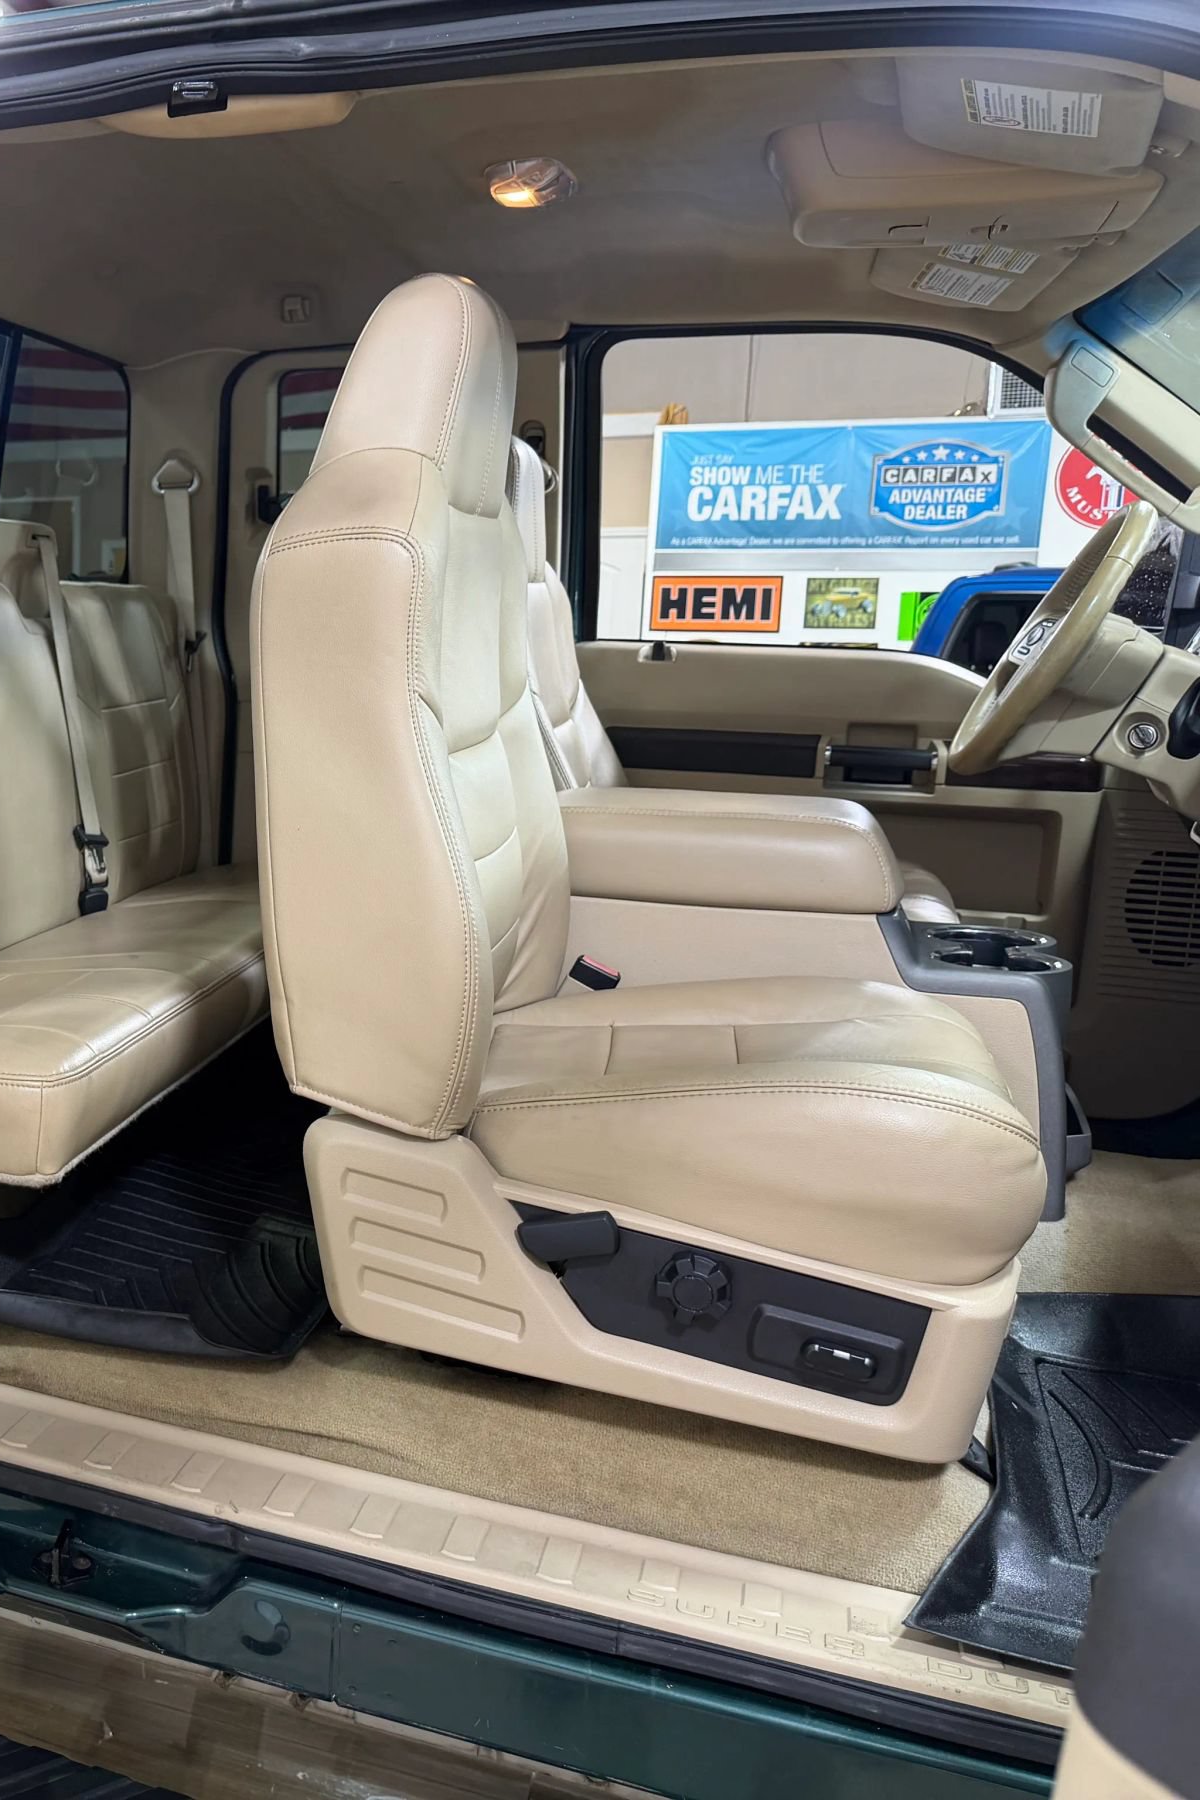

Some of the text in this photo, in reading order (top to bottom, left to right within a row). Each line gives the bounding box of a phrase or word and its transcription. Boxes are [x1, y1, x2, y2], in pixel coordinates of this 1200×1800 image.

[691, 455, 714, 465] JUST
[689, 463, 825, 486] SHOW ME THE
[885, 465, 993, 484] CARFAX
[687, 484, 843, 522] CARFAX
[888, 487, 987, 504] ADVANTAGE
[1066, 486, 1117, 521] MUST
[903, 504, 968, 521] DEALER
[658, 586, 775, 622] HEMI
[626, 1588, 1076, 1705] SUPER DUT
